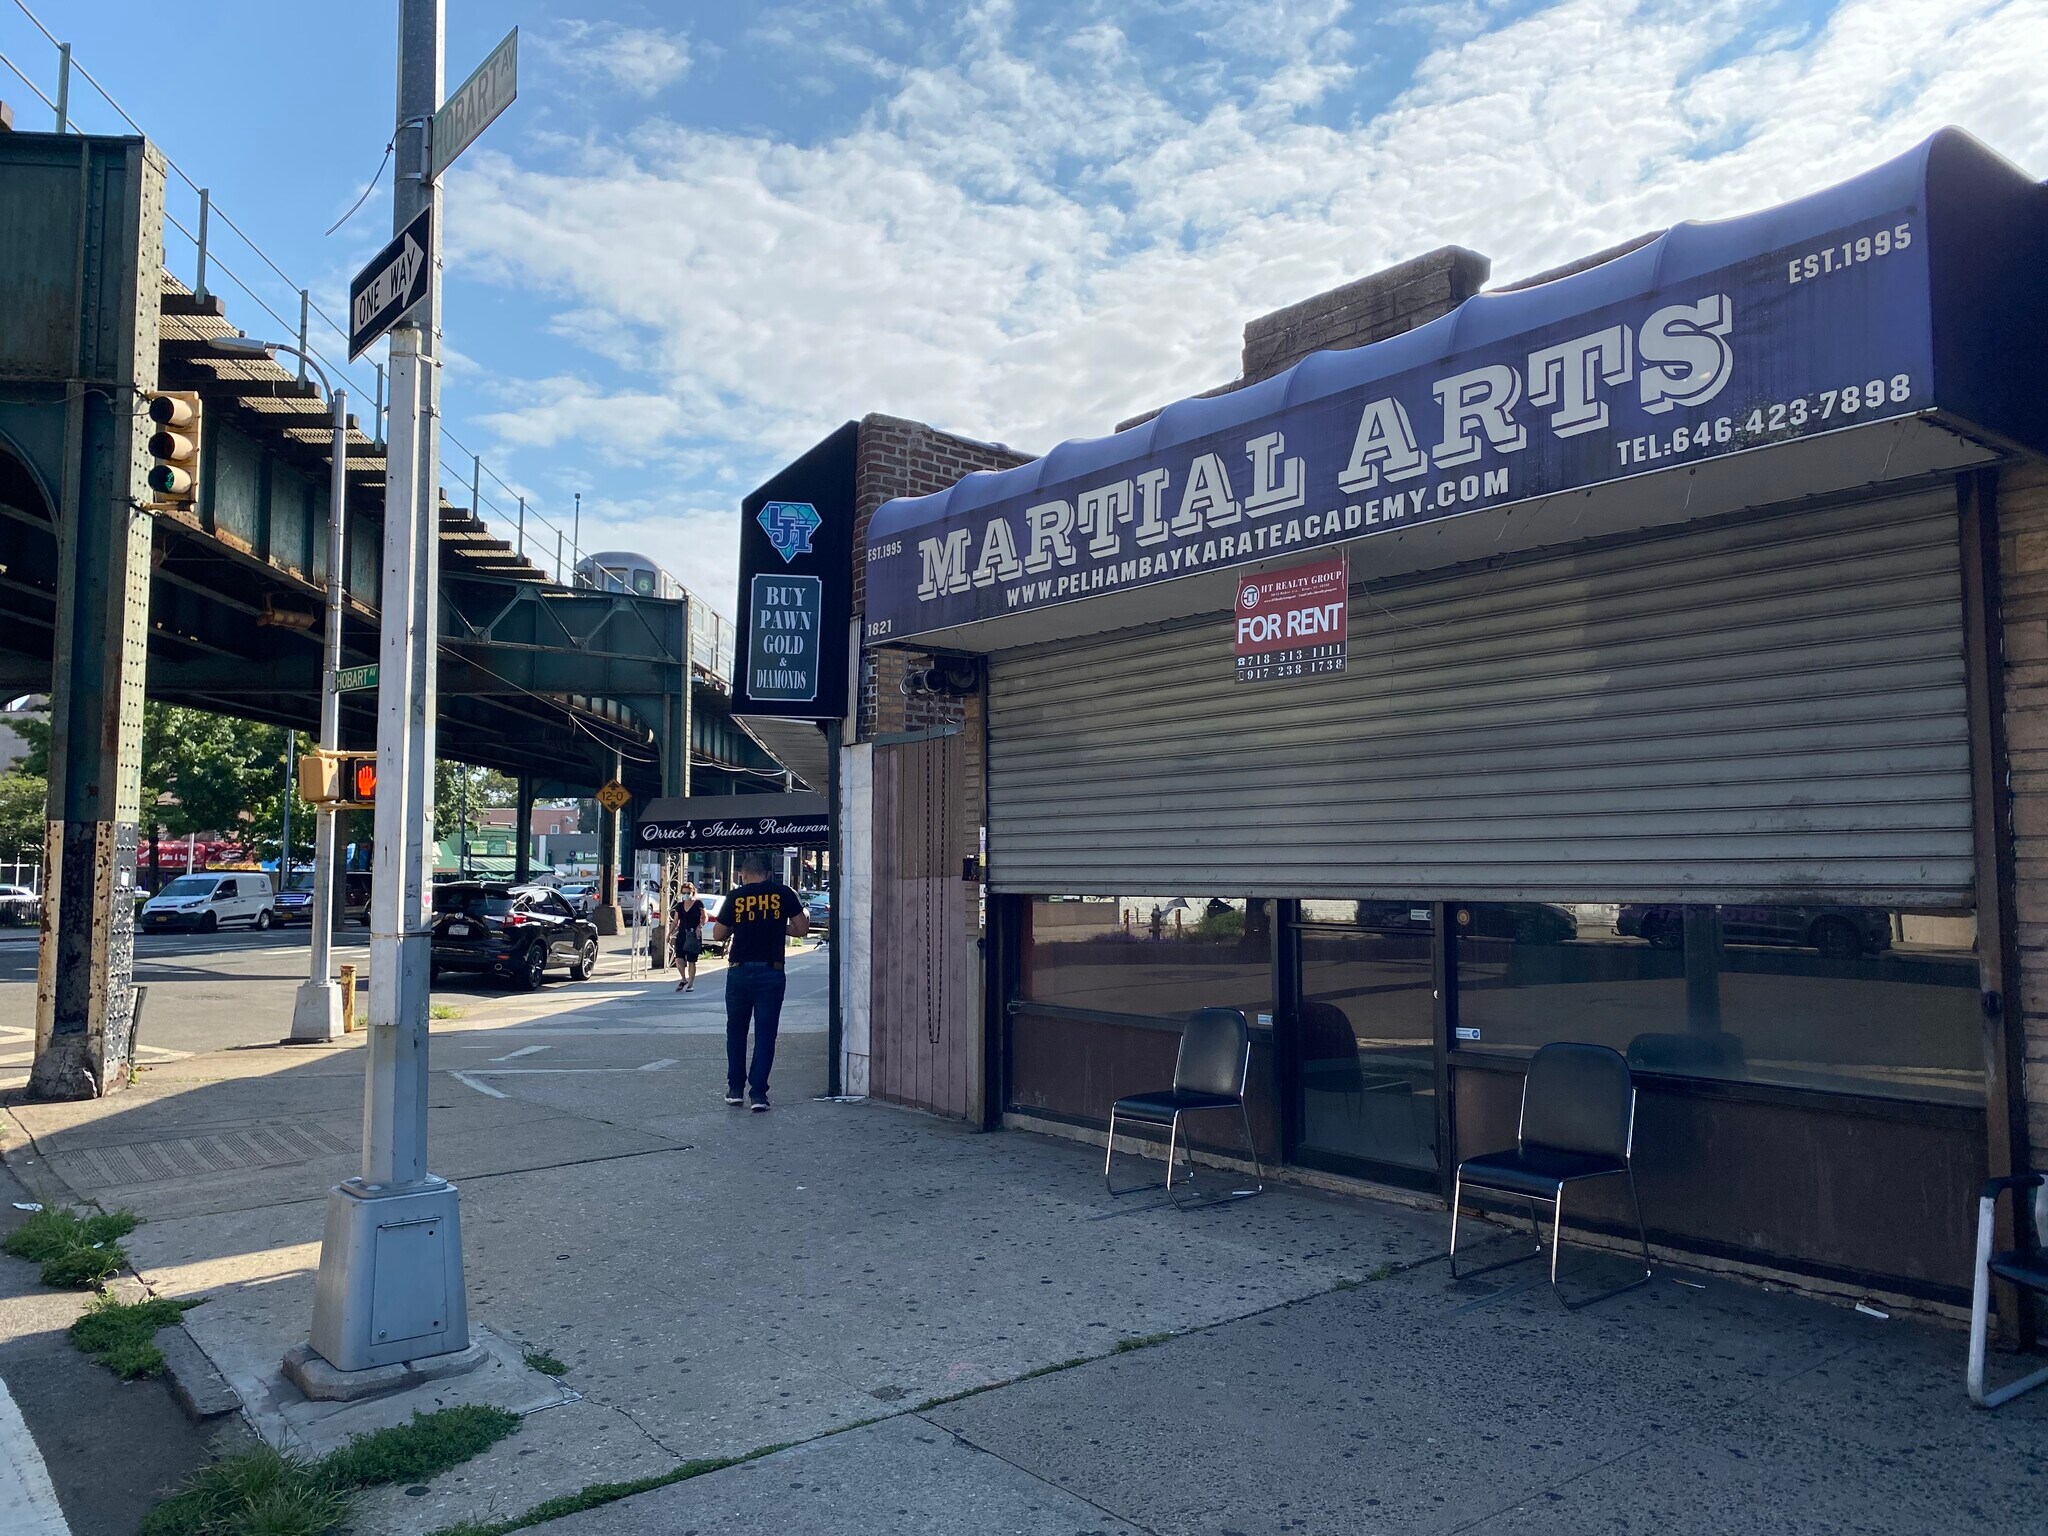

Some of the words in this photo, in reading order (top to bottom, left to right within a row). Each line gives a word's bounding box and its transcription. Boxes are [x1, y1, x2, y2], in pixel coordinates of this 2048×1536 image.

[433, 55, 500, 168] HOBART
[501, 40, 515, 77] AV
[1788, 223, 1913, 284] EST.1995
[359, 282, 381, 326] ONE
[389, 247, 416, 298] WAY
[918, 431, 1306, 602] MARTIAL
[1338, 293, 1732, 495] ARTS
[1007, 468, 1510, 607] WWW.PELHAMBAYKARATEACADEMY.COM
[868, 540, 902, 562] EST.1995
[639, 579, 649, 591] 6
[1275, 576, 1309, 590] REALTY
[1311, 570, 1342, 583] GROUP
[766, 586, 807, 607] BUY
[760, 609, 812, 631] PAWN
[867, 620, 892, 637] 1821
[1237, 613, 1282, 645] FOR
[1286, 602, 1344, 638] RENT
[763, 634, 804, 655] GOLD
[1248, 644, 1341, 665] 718-513-1111
[779, 657, 788, 667] &
[1247, 659, 1342, 679] 917-238-1738
[336, 669, 368, 690] HOBART
[369, 666, 377, 677] AV
[756, 669, 807, 690] DIAMONDS
[642, 820, 697, 841] Orrico's
[702, 821, 754, 837] Italian
[735, 893, 781, 913] SPHS
[735, 909, 780, 923] 2019
